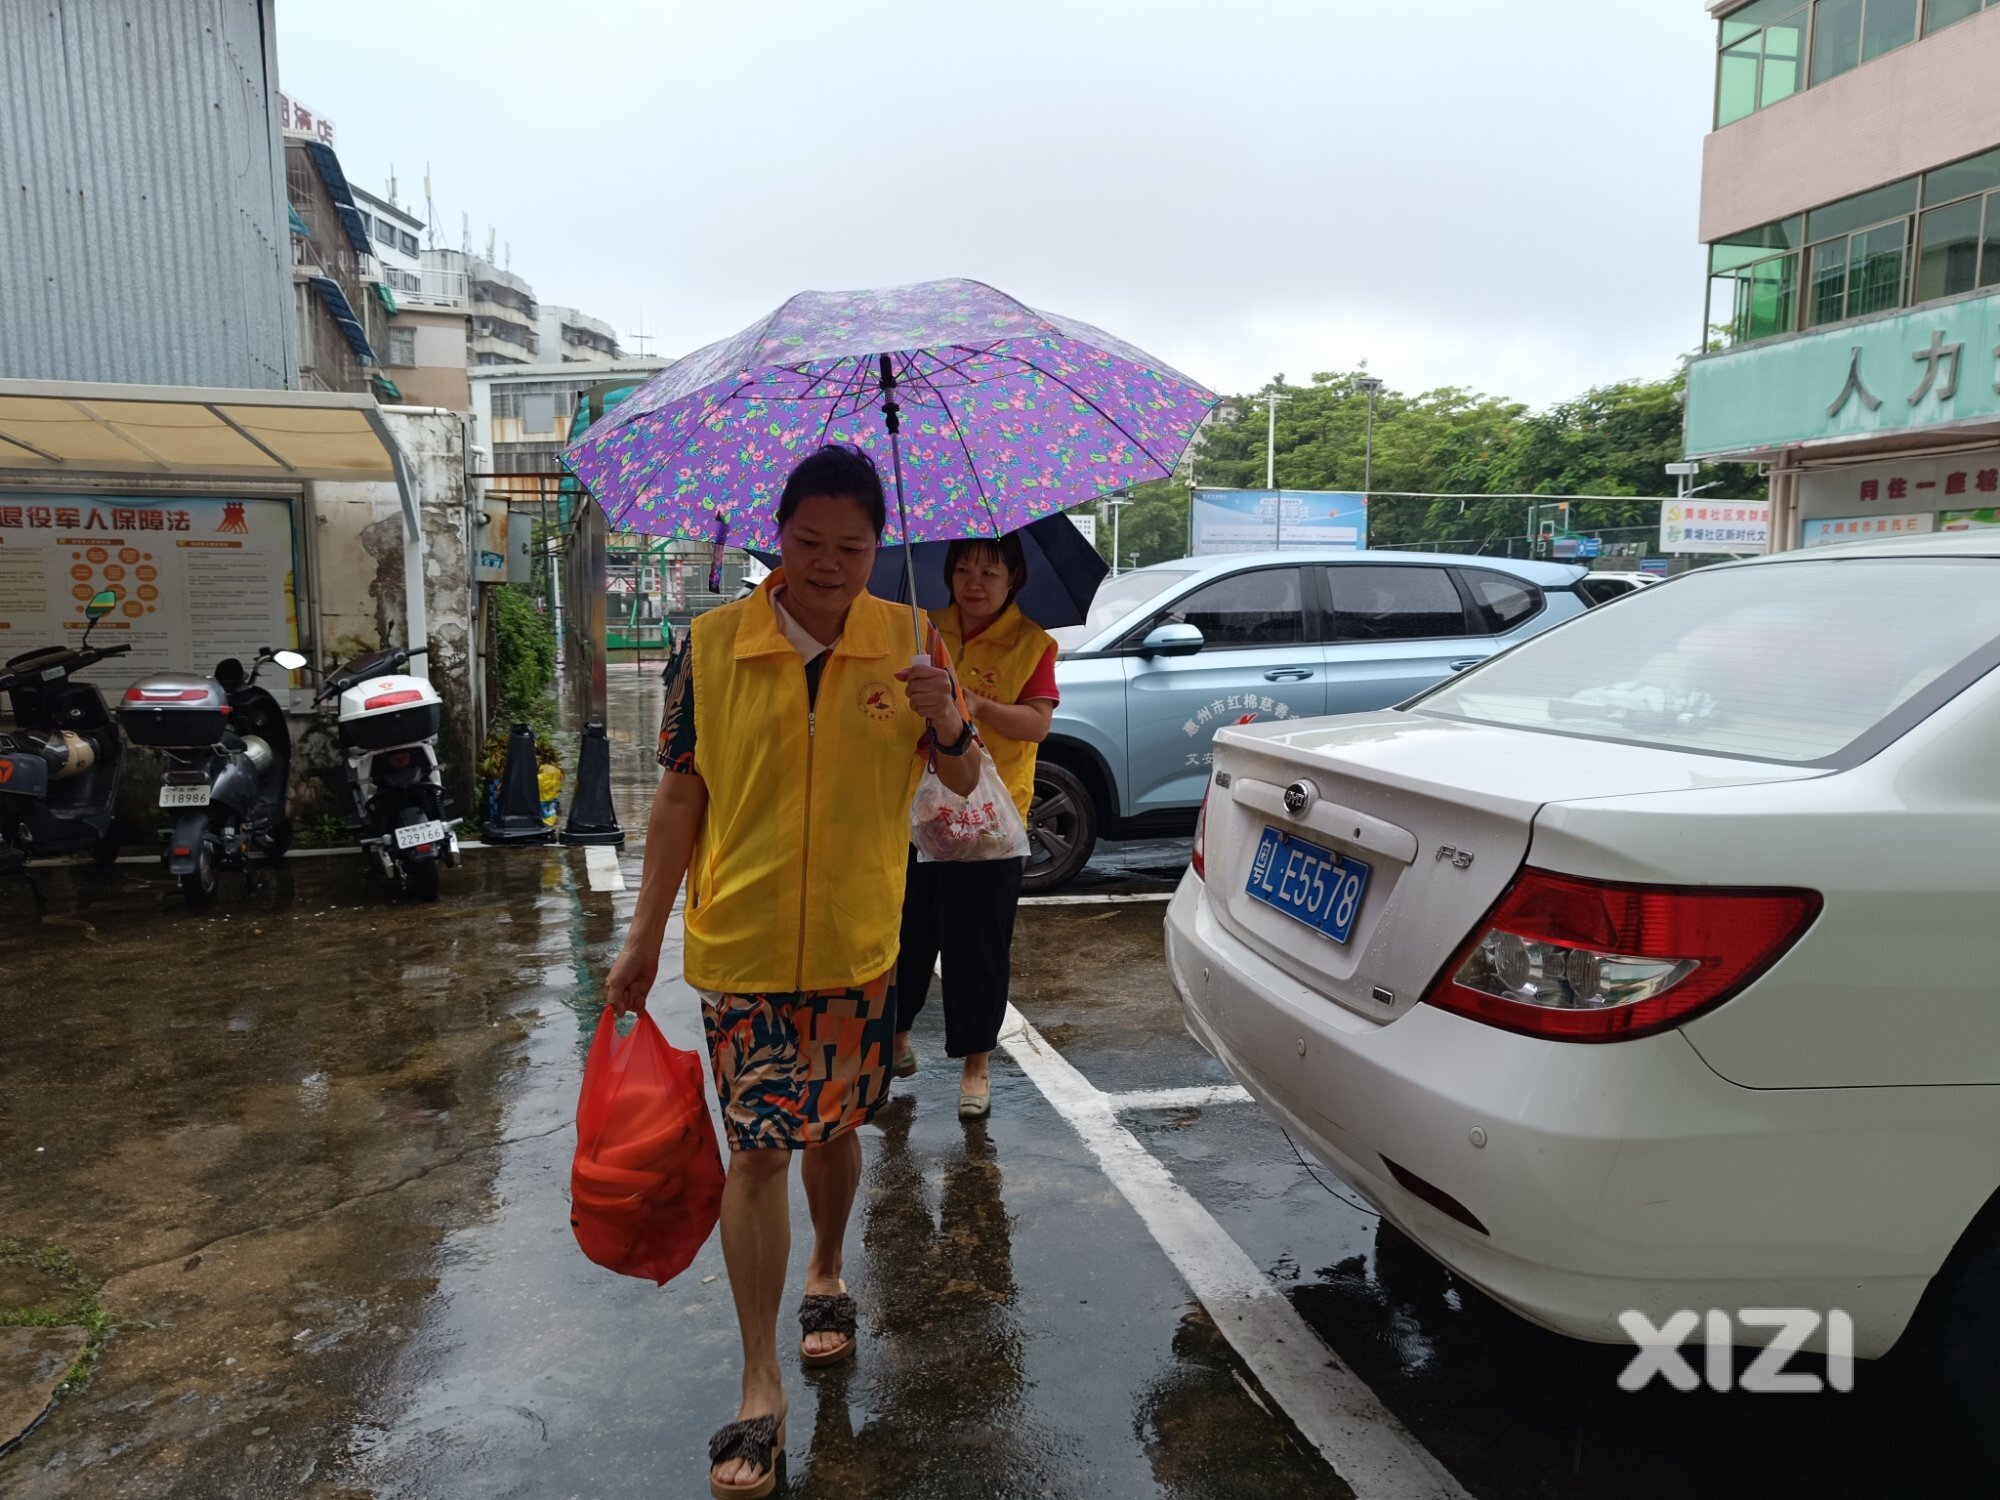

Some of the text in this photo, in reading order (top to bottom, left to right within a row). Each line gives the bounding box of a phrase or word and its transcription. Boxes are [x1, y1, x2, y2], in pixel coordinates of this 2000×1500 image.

[1826, 329, 2000, 418] 人力
[0, 505, 191, 531] 退役军人保障法
[1684, 528, 1766, 542] 黄塘社区新时代文
[162, 793, 207, 805] 318986
[1435, 844, 1474, 869] F3
